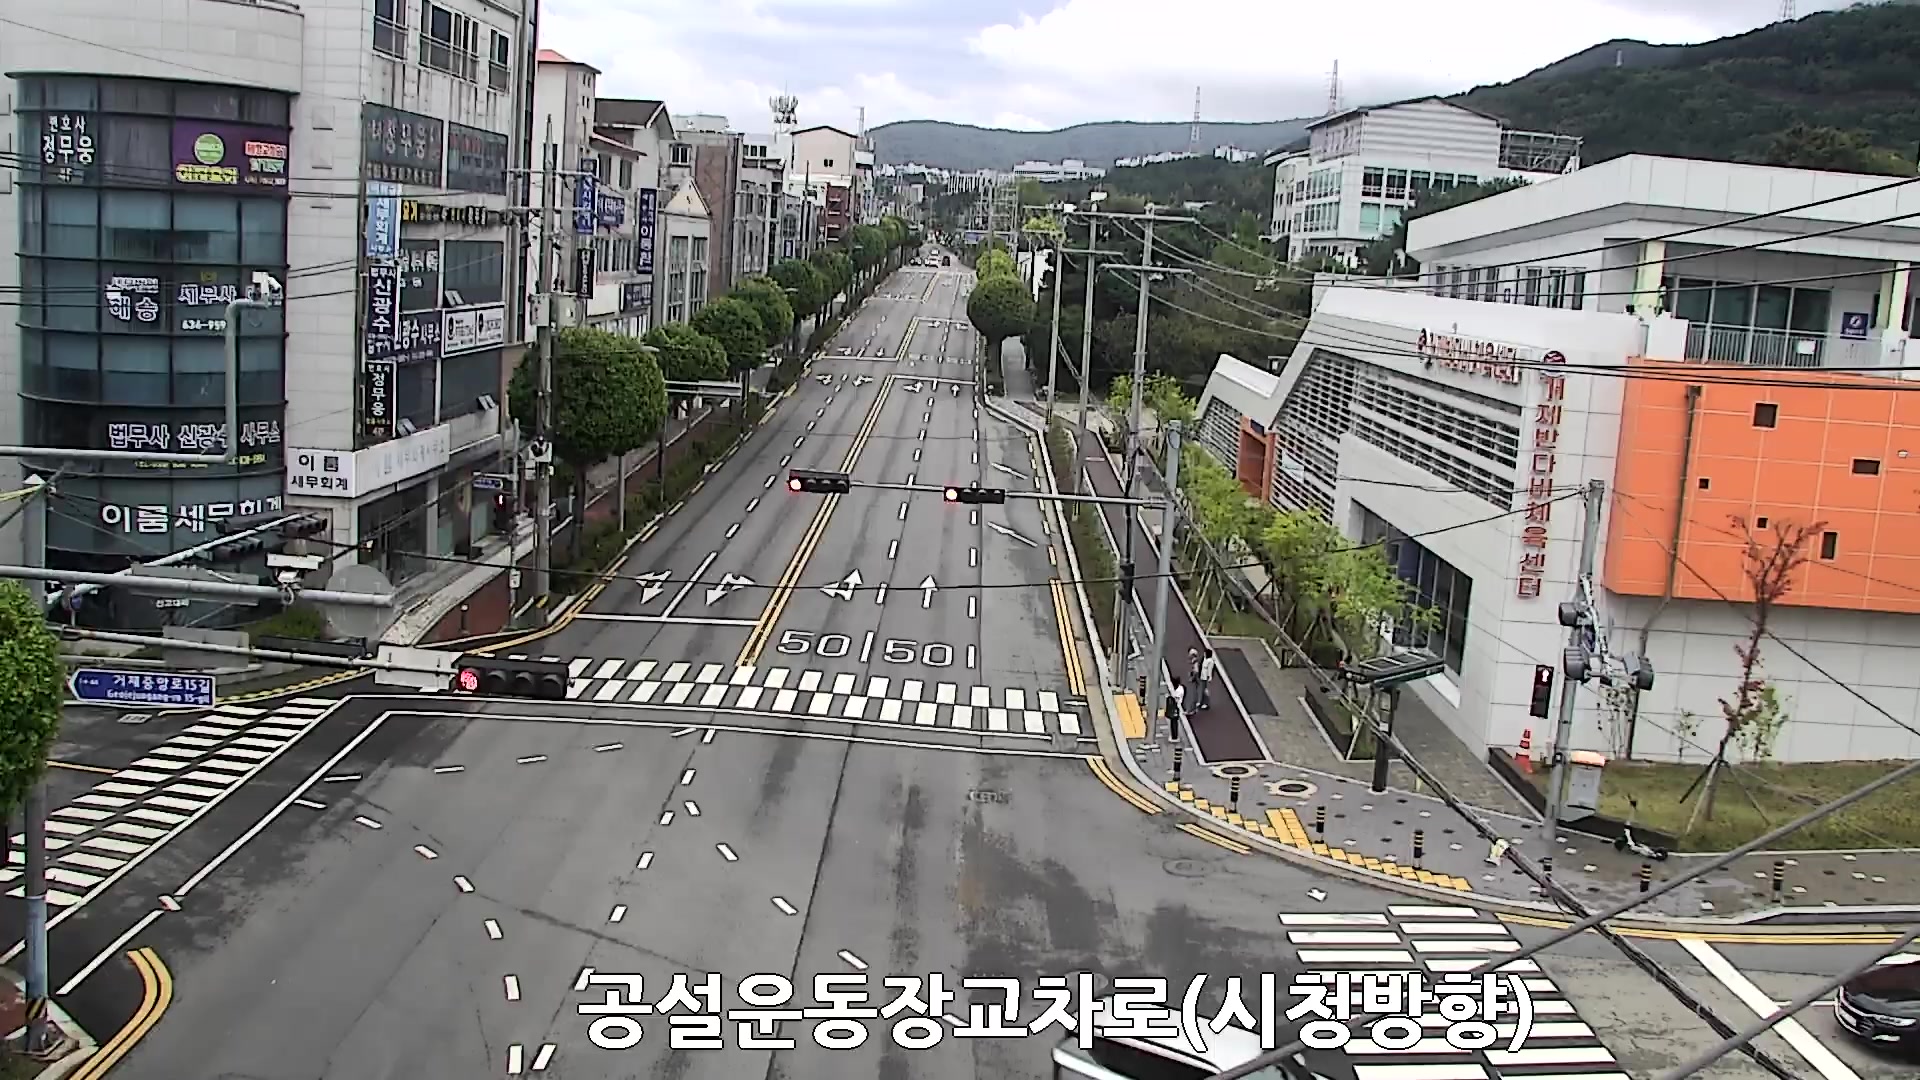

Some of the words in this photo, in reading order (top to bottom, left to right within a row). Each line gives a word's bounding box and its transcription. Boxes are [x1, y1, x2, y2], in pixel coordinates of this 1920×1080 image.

[43, 134, 95, 164] 정무웅
[178, 284, 237, 306] 세무사
[371, 372, 387, 416] 정무웅
[108, 423, 170, 450] 법무사
[240, 420, 281, 447] 사무소
[291, 475, 349, 492] 세무회계
[776, 629, 852, 657] 50
[883, 639, 953, 666] 50
[107, 689, 182, 702] Geojejungang-ro
[113, 674, 210, 693] 거제중앙로15길
